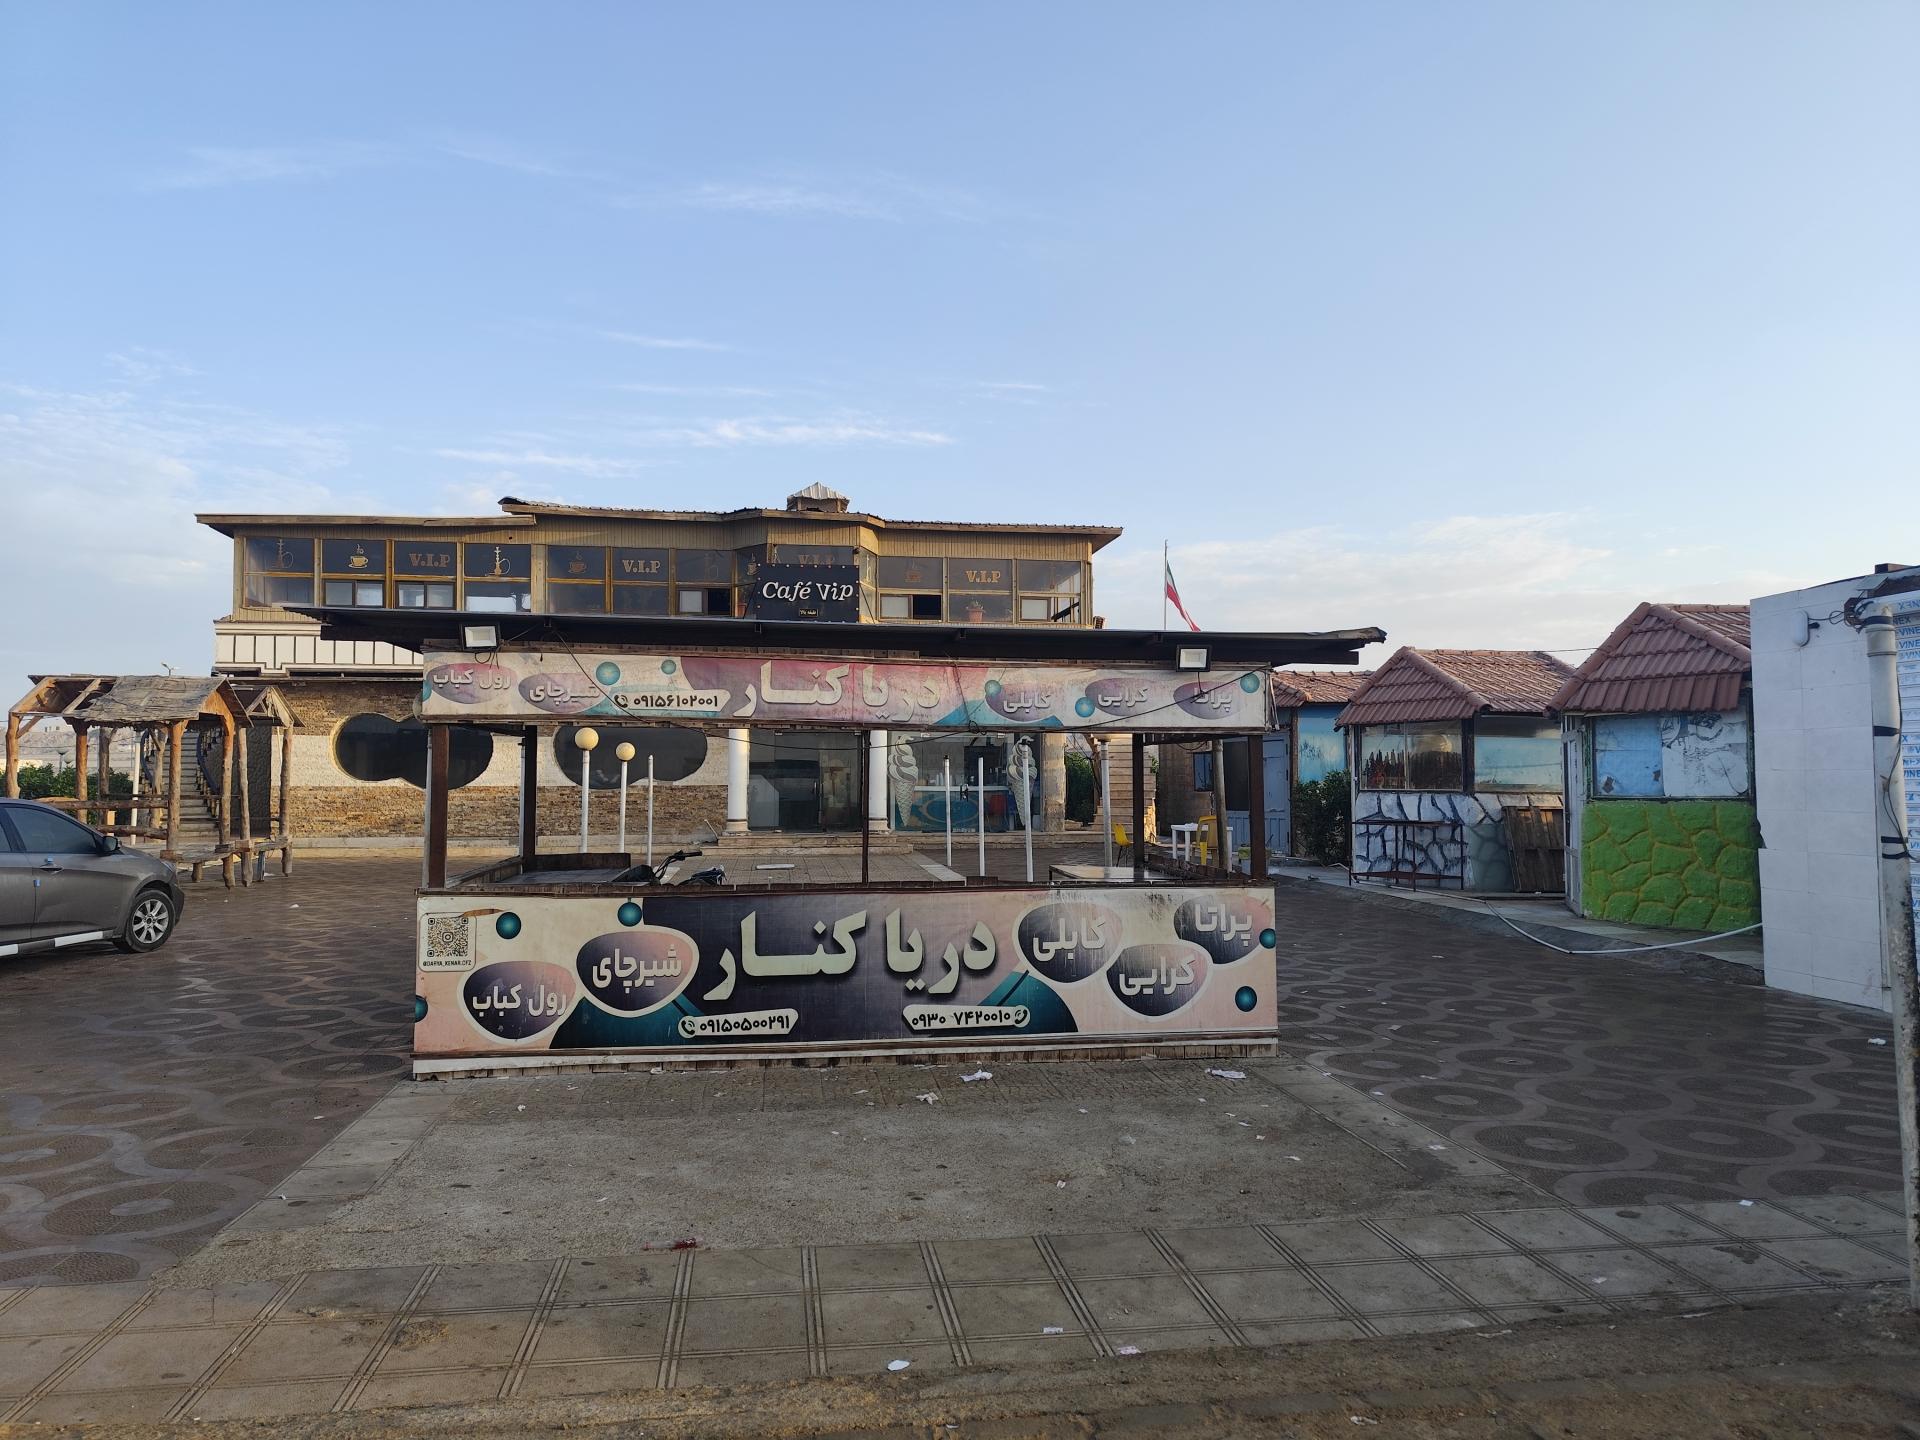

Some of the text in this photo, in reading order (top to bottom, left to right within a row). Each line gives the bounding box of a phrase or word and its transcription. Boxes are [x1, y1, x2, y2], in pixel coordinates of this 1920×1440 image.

[409, 553, 450, 568] V.I.P
[622, 559, 661, 573] V.I.P
[965, 570, 1001, 583] V.I.P
[762, 581, 854, 602] Café Vip
[433, 667, 512, 691] رول کباب
[529, 680, 601, 707] شیرچای
[634, 695, 718, 707] ۰۹۱۵۶۱۰۲۰۰۱
[733, 660, 941, 723] دریا کنار
[1002, 690, 1052, 712] کابلی
[1098, 685, 1150, 707] کرایی
[1194, 902, 1253, 947] پراتا
[1032, 914, 1108, 962] کابلی
[703, 908, 998, 1001] دریا کنار
[591, 943, 683, 994] شیرچای
[1118, 952, 1197, 997] کرایی
[471, 983, 568, 1018] رول کباب
[699, 1014, 791, 1034] ۰۹۱۵۰۵۰۰۲۹۱
[911, 1010, 1011, 1028] ۰۹۳۰ ۷۴۲۰۰۱۰
